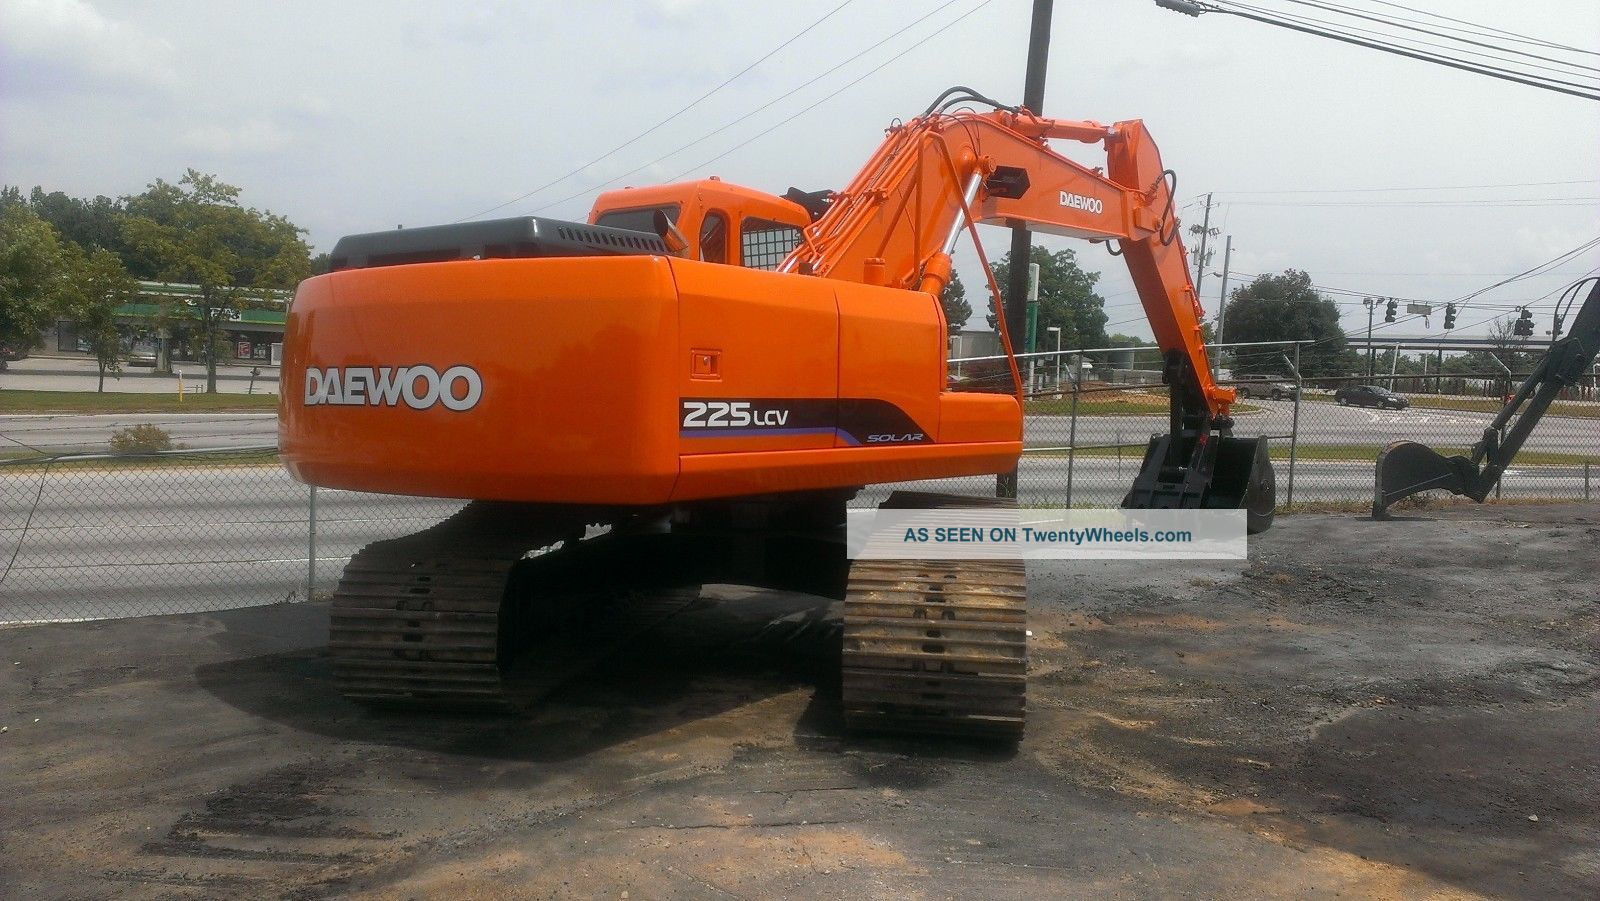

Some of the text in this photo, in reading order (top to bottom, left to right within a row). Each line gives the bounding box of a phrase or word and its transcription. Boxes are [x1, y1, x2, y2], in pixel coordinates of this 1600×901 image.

[1059, 190, 1103, 214] DAEWOO
[304, 365, 482, 411] DAEWOO
[866, 433, 923, 442] SOLAR
